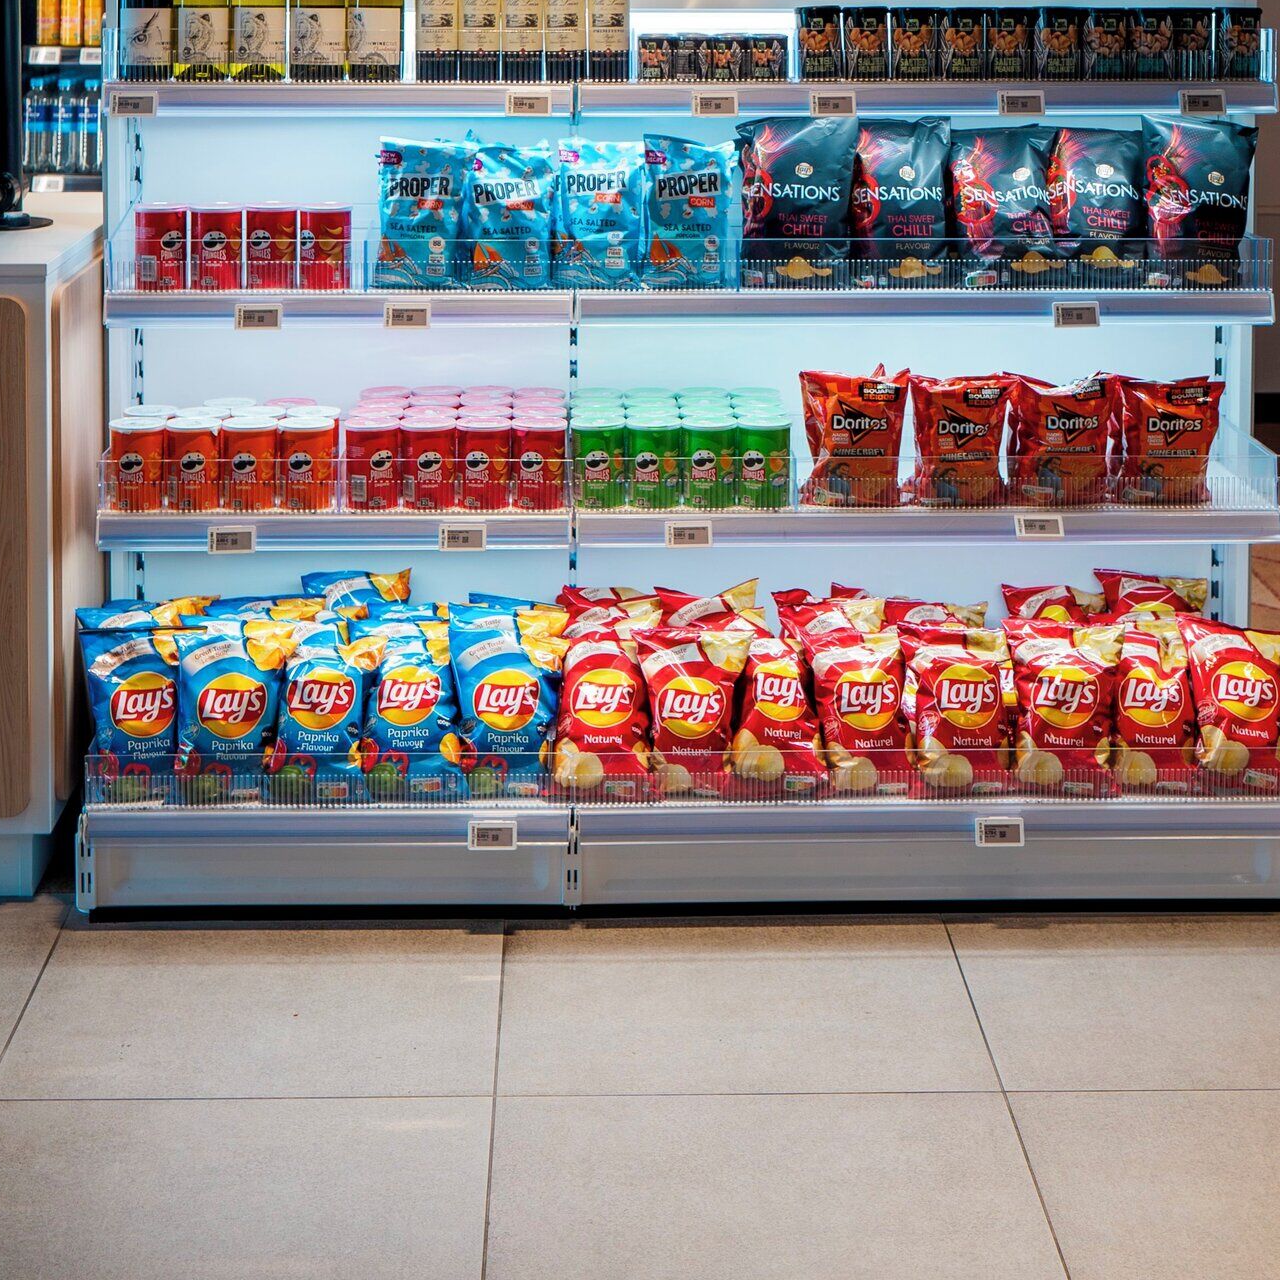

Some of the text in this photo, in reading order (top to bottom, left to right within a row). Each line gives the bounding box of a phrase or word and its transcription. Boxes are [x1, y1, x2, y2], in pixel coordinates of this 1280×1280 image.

[389, 176, 450, 197] PROPER
[567, 171, 627, 193] PROPER
[658, 172, 719, 198] PROPER
[473, 179, 538, 203] PROPER
[853, 186, 943, 205] SENSATIONS
[596, 194, 620, 203] CORN
[690, 197, 715, 207] CORN
[420, 200, 443, 210] CORN
[508, 201, 533, 210] CORN
[800, 214, 828, 223] SWEET
[1082, 206, 1131, 219] THAI SWEET
[585, 218, 616, 227] SALTED
[887, 215, 935, 223] THAI SWEET
[1087, 215, 1127, 230] CHILLI
[390, 222, 437, 233] SEA SALTED
[500, 227, 531, 235] SALTED
[664, 223, 712, 231] SEA SALTED
[783, 224, 823, 236] CHILLI
[892, 225, 933, 236] CHILLI
[896, 242, 930, 250] FLAVOUR
[249, 248, 271, 259] PRINGLES
[833, 415, 888, 430] Doritos
[939, 420, 989, 435] Doritos
[1047, 416, 1098, 429] Doritos
[1149, 418, 1201, 431] Doritos
[833, 448, 885, 456] MINECRAFT
[1148, 449, 1198, 457] MINECRAFT
[370, 469, 393, 480] PRINGLES
[418, 470, 442, 481] PRINGLES
[466, 470, 489, 482] PRINGLES
[520, 470, 543, 482] PRINGLES
[585, 469, 610, 481] PRINGLES
[691, 468, 716, 480] PRINGLES
[290, 678, 351, 714] Lay's
[380, 677, 440, 712] Lay's
[940, 679, 996, 714] Lay's
[1035, 674, 1096, 714] Lay's
[1124, 678, 1180, 712] Lay's
[1218, 675, 1273, 707] Lay's
[116, 685, 173, 723] Lay's
[478, 682, 537, 716] Lay's
[575, 682, 634, 714] Lay's
[840, 681, 895, 716] Lay's
[202, 686, 264, 724] Lay's
[662, 690, 721, 724] Lay's
[297, 731, 339, 744] Paprika
[387, 728, 429, 740] Paprika
[764, 728, 802, 739] Naturel
[1231, 725, 1270, 740] Naturel
[392, 738, 424, 749] Flavour
[487, 733, 529, 746] Paprika
[584, 734, 623, 744] Naturel
[855, 736, 894, 749] Naturel
[953, 736, 992, 747] Naturel
[1044, 733, 1084, 747] Naturel
[1136, 733, 1177, 745] Naturel
[128, 739, 170, 753] Paprika
[212, 740, 254, 753] Paprika
[301, 742, 334, 752] Flavour
[672, 746, 712, 757] Naturel
